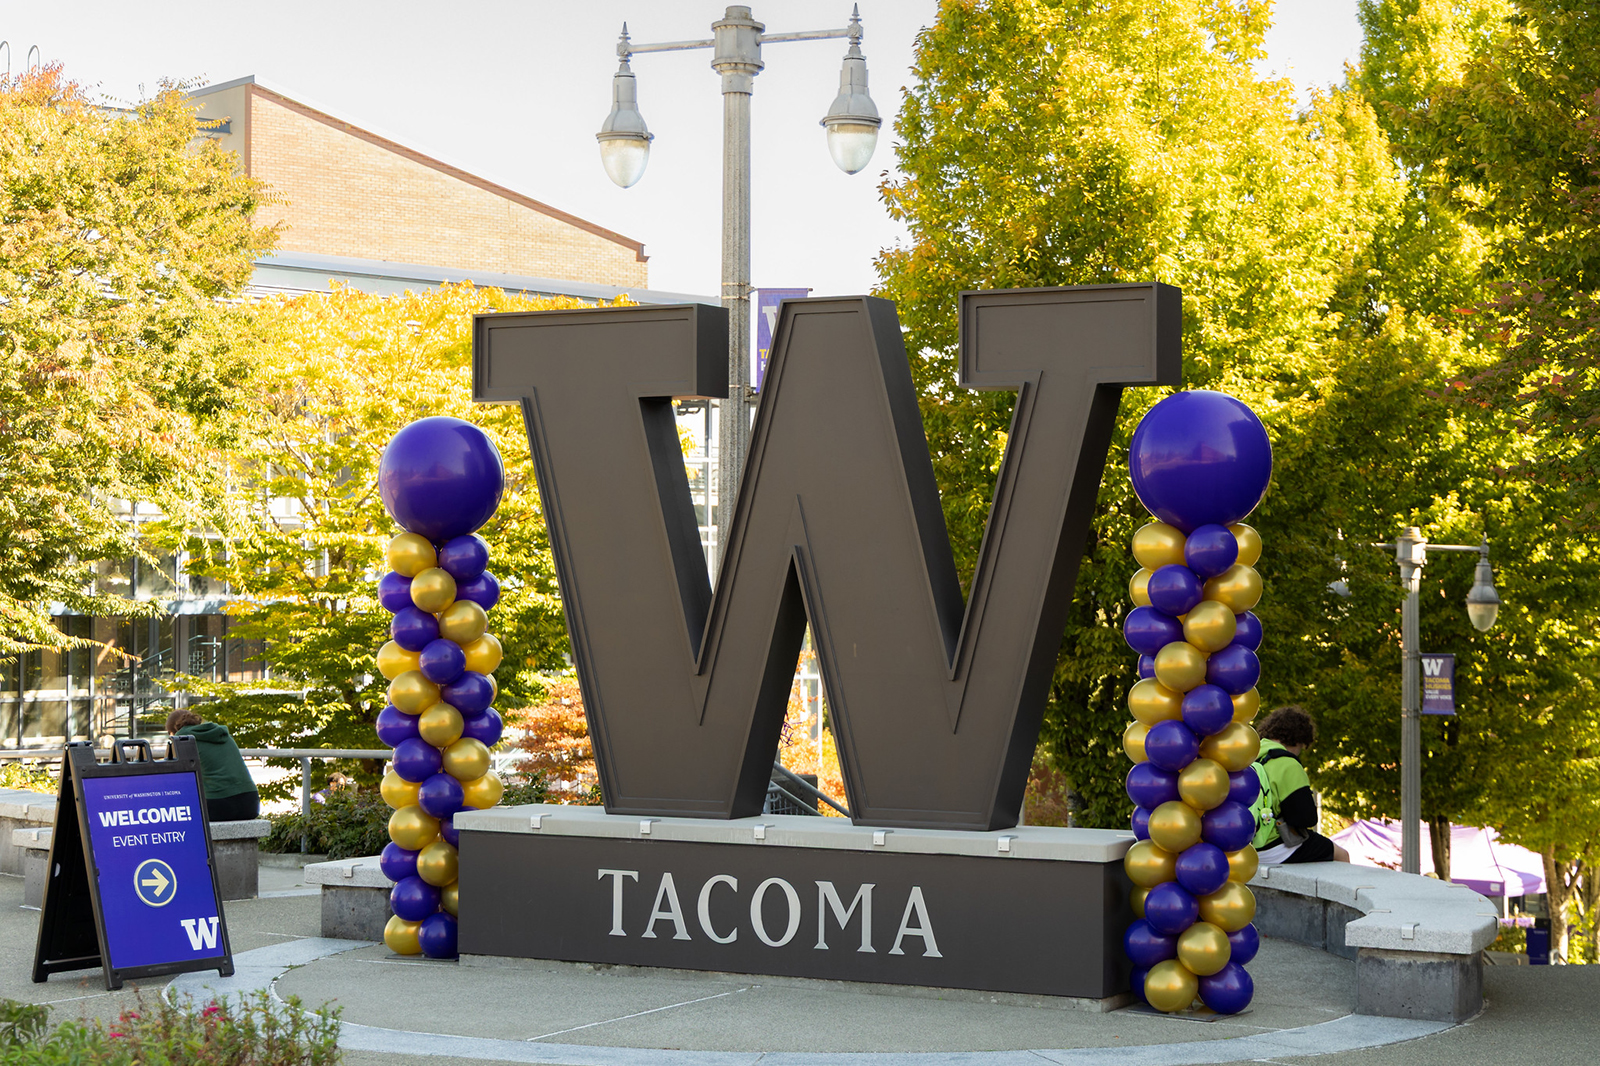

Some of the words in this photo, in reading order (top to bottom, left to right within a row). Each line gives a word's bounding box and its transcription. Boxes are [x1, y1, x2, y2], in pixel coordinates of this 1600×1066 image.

[472, 283, 1181, 831] W
[1421, 659, 1444, 676] W
[98, 806, 192, 827] WELCOME!
[112, 834, 149, 848] EVENT
[151, 831, 186, 845] ENTRY
[598, 868, 943, 958] TACOMA
[180, 916, 219, 951] W
